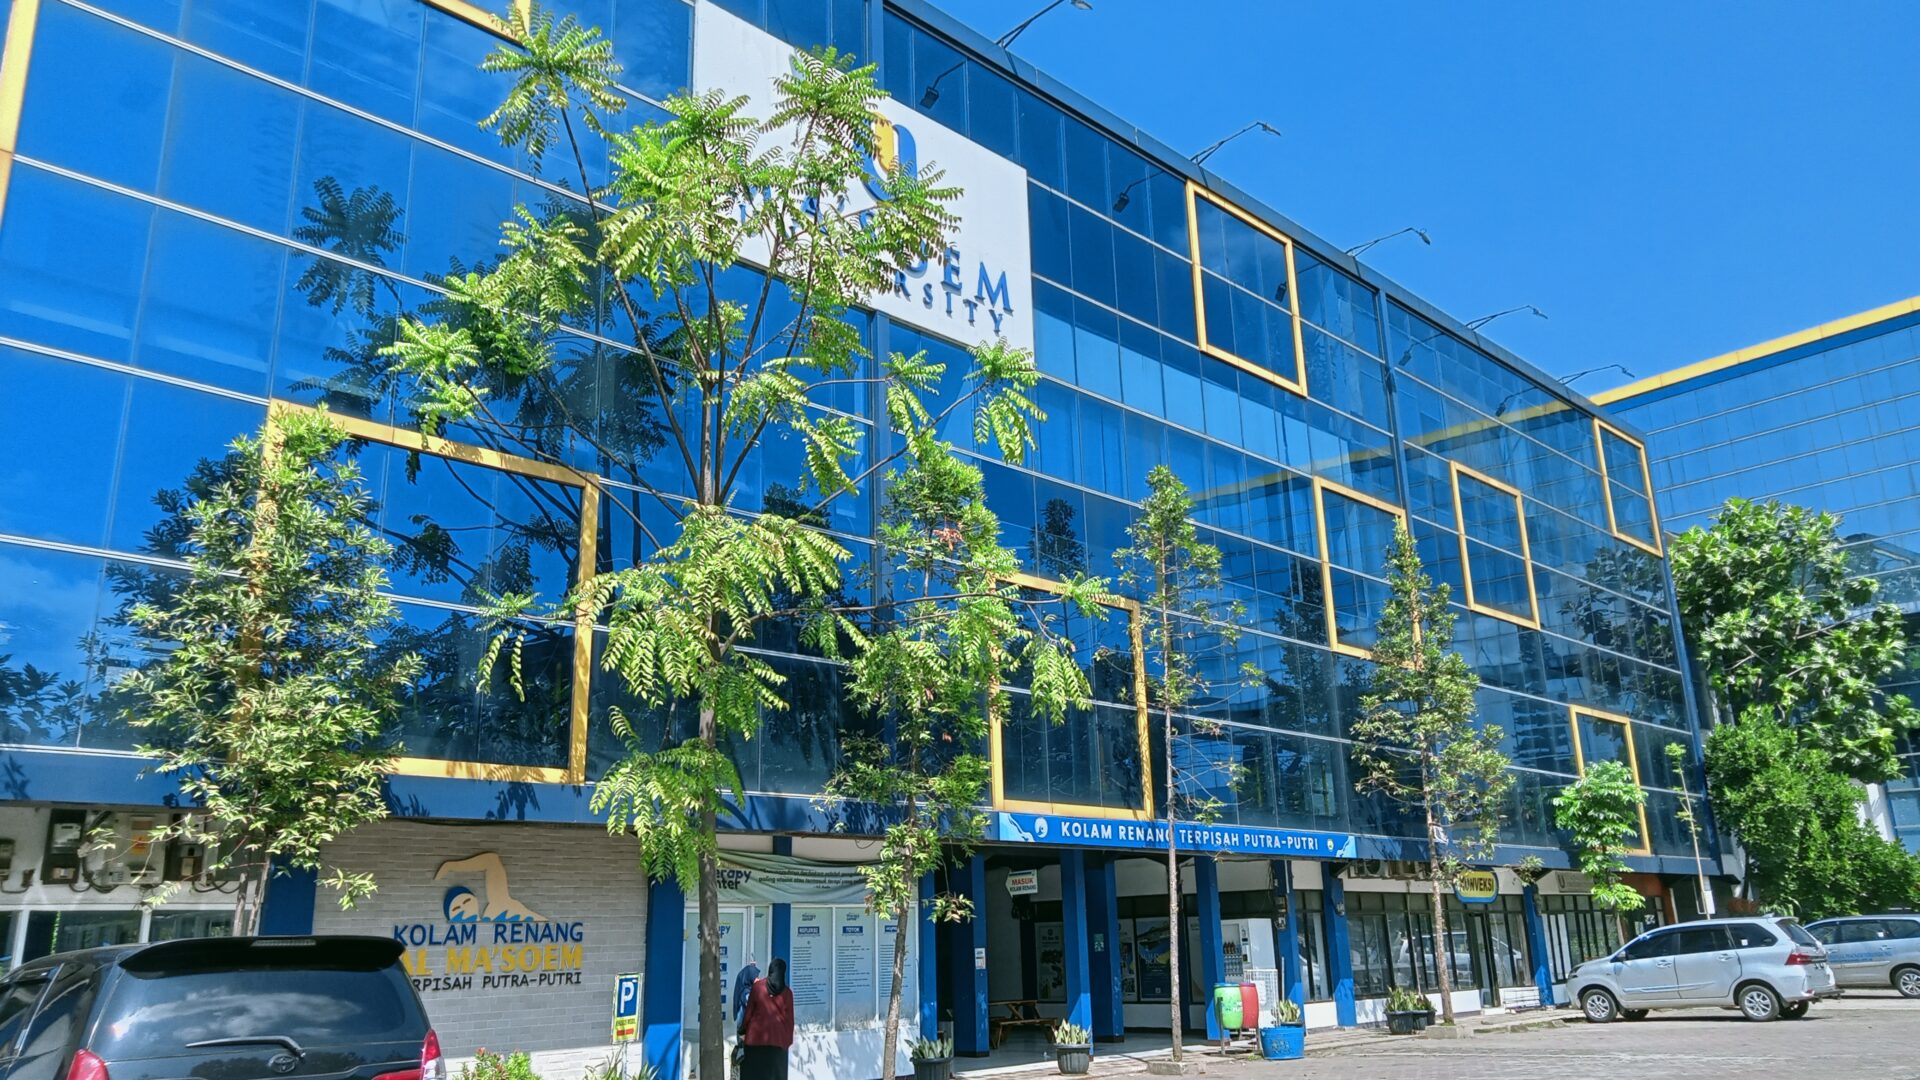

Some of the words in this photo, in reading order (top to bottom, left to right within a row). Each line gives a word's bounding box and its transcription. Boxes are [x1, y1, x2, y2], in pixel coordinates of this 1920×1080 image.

[1061, 821, 1112, 840] KOLAM
[1179, 829, 1239, 847] TERPISAH
[1244, 833, 1319, 850] PUTRA-PUTRI
[717, 869, 751, 883] rapy
[717, 879, 741, 890] nter
[1012, 878, 1034, 886] MASUK
[394, 924, 477, 946] KOLAM
[494, 922, 583, 944] RENANG
[444, 944, 583, 975] MA'SOEM
[410, 976, 472, 992] RPISAH
[482, 972, 582, 988] PUTRA-PUTRI
[620, 981, 635, 1014] P
